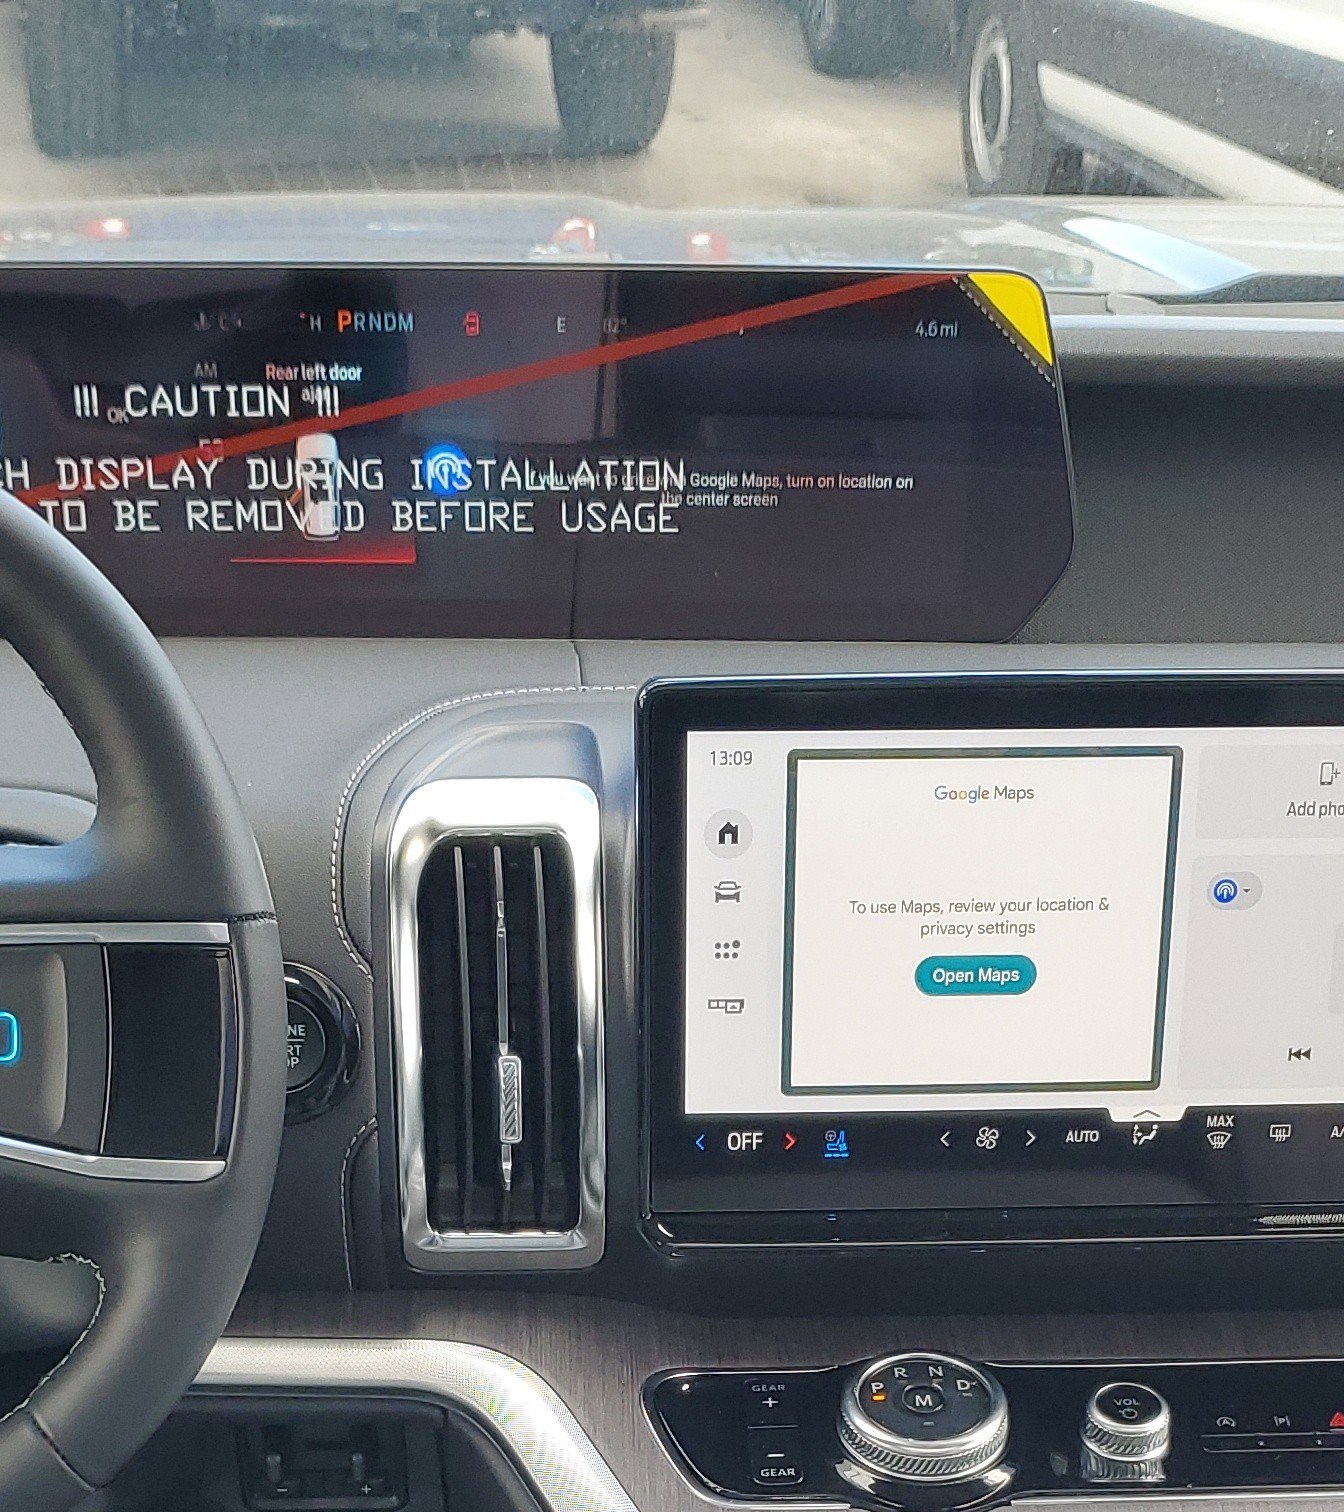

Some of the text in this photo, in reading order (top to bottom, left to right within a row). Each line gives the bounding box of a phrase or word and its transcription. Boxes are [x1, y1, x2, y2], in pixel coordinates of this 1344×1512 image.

[557, 316, 566, 333] E
[915, 320, 958, 338] 4.6 mi
[194, 360, 218, 379] AM
[265, 361, 362, 381] Rear left door
[124, 384, 290, 418] CAUTION
[56, 455, 220, 491] DISPLAY
[246, 455, 384, 491] DURING
[410, 455, 684, 492] INSTALLATION
[690, 471, 738, 489] Google
[742, 471, 783, 490] Maps,
[786, 472, 814, 488] turn
[817, 475, 835, 488] on
[838, 472, 892, 489] location
[895, 475, 914, 490] on
[686, 492, 731, 507] center
[733, 493, 779, 507] screen
[38, 499, 680, 533] TO BE REMOVED BEFORE USAGE
[709, 749, 753, 767] 13:09
[934, 784, 1035, 804] Google Maps
[1286, 801, 1317, 817] Add
[849, 897, 1109, 917] To use Maps, review your location &
[920, 919, 1036, 938] privacy settings
[932, 967, 1020, 987] Open Maps
[1206, 1115, 1234, 1128] MAX
[726, 1133, 763, 1151] OFF
[1065, 1129, 1099, 1143] AUTO
[893, 1366, 943, 1378] R N
[751, 1384, 785, 1392] GEAR
[871, 1382, 884, 1393] P
[956, 1379, 970, 1391] D
[915, 1395, 933, 1407] M
[1113, 1398, 1141, 1406] VOL
[760, 1467, 796, 1478] GEAR
